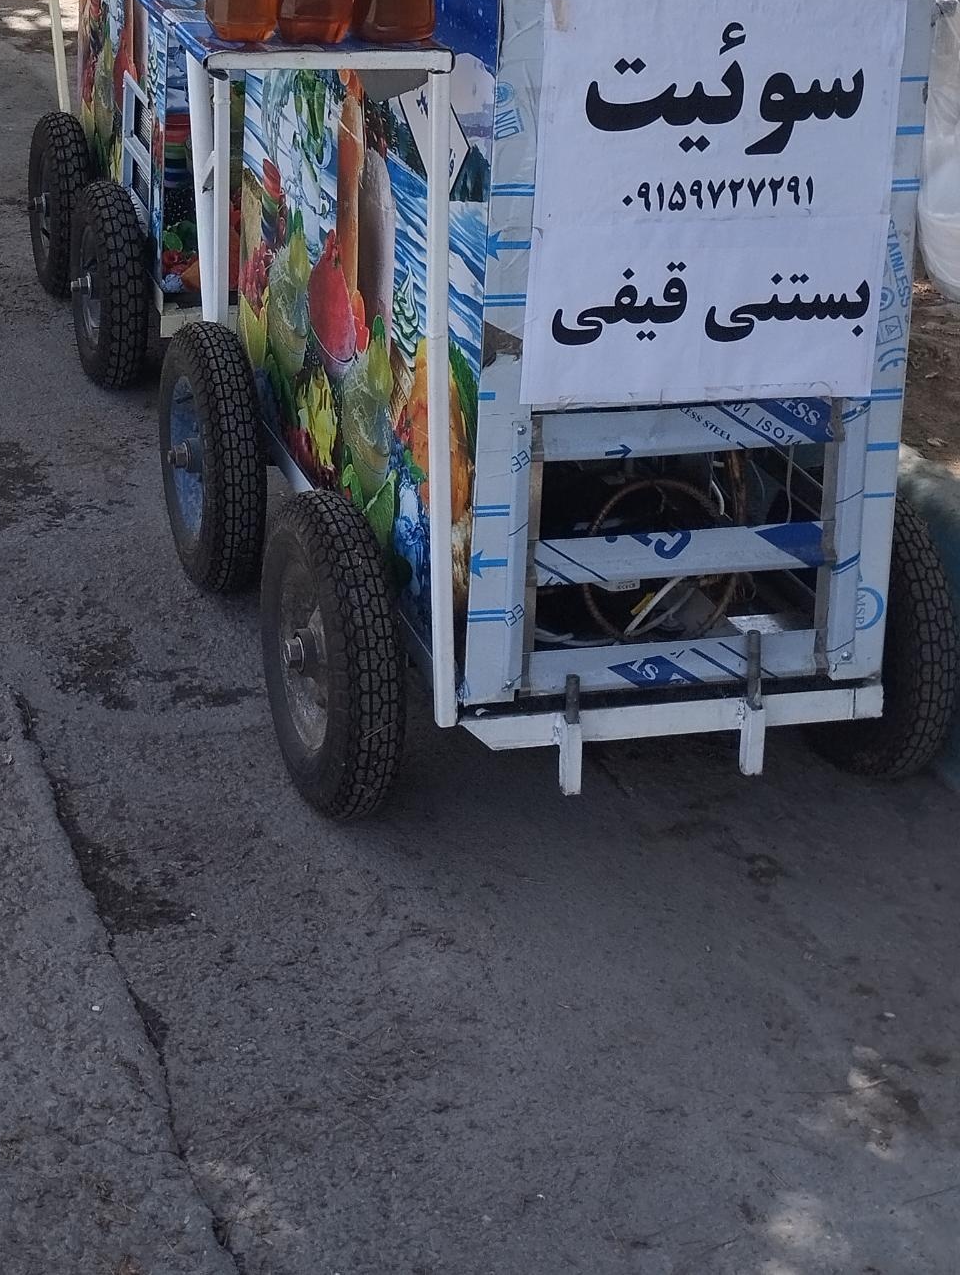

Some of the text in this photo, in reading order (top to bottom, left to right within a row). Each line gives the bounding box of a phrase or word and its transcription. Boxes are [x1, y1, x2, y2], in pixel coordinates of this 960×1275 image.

[585, 22, 865, 156] سوئیت
[621, 175, 814, 212] ۰۹۱۵۹۷۲۷۲۹۱
[551, 261, 872, 346] بستنی قیفی
